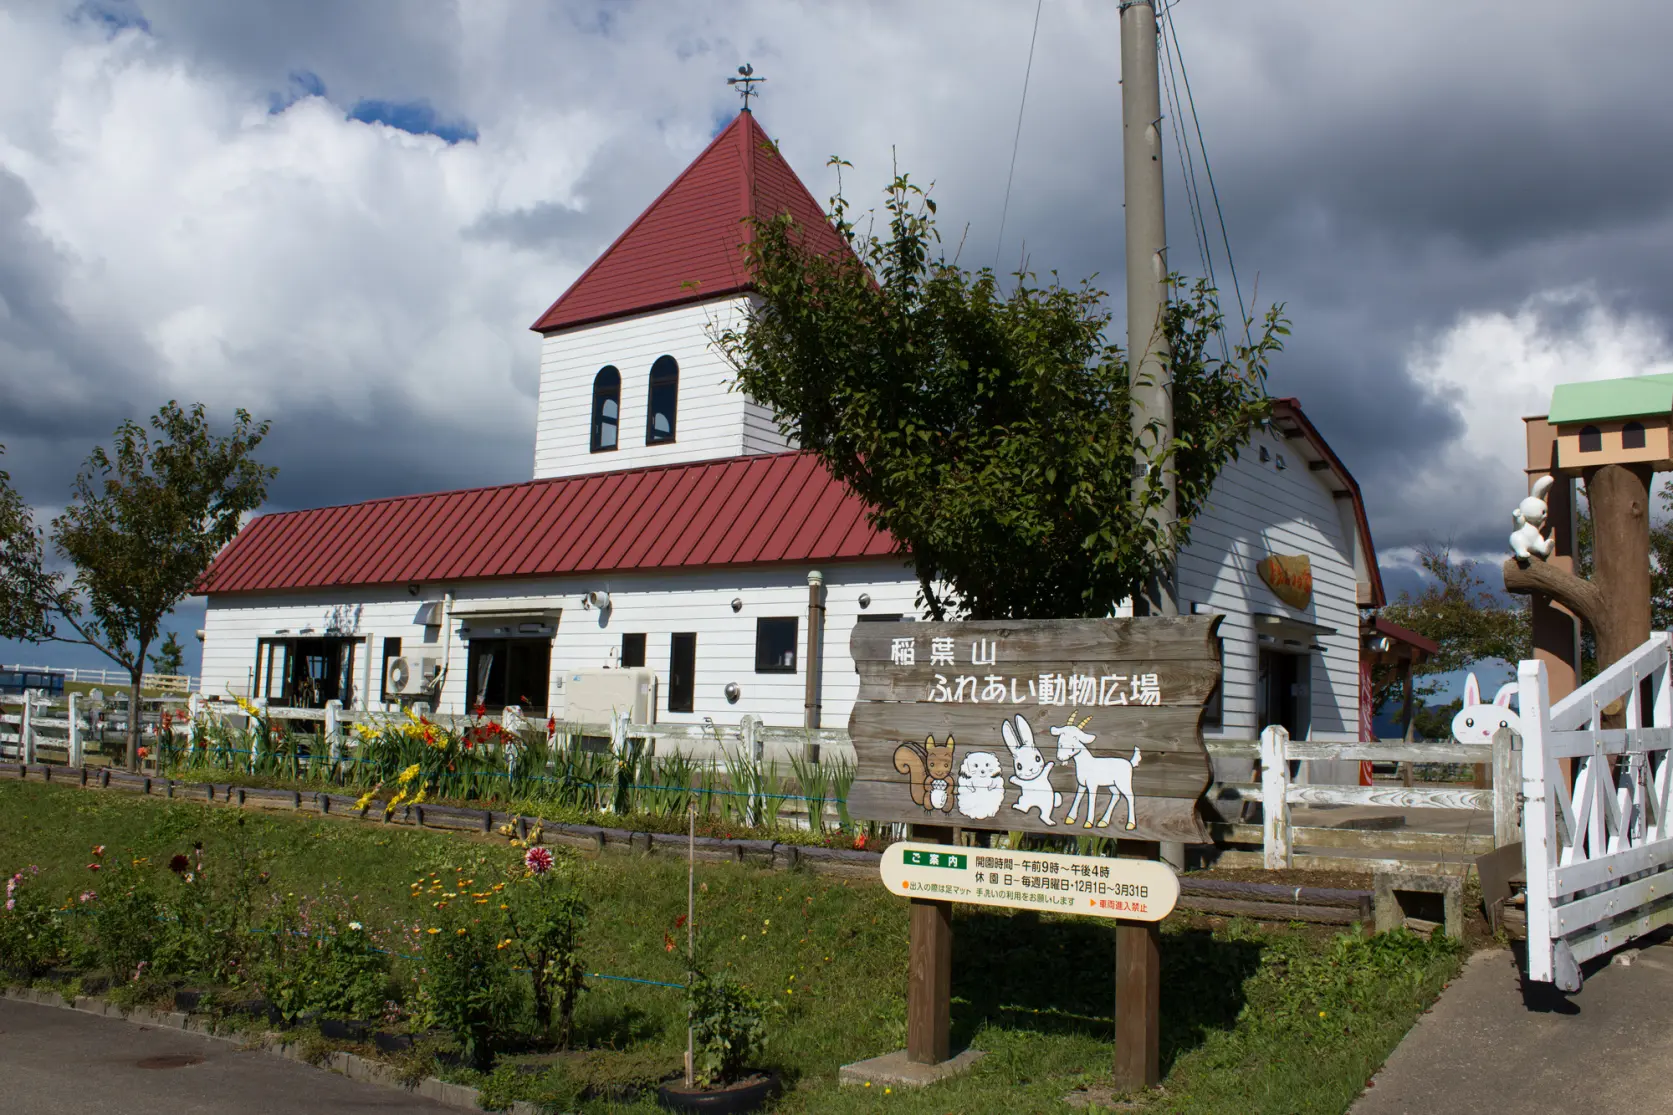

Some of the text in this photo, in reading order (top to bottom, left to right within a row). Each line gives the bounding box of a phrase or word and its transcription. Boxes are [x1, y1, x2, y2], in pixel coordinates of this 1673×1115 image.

[890, 637, 997, 666] 稲葉山
[928, 673, 1161, 706] ふれあい動物広場
[912, 852, 958, 867] ご案内
[1099, 900, 1148, 913] 車両進入禁止
